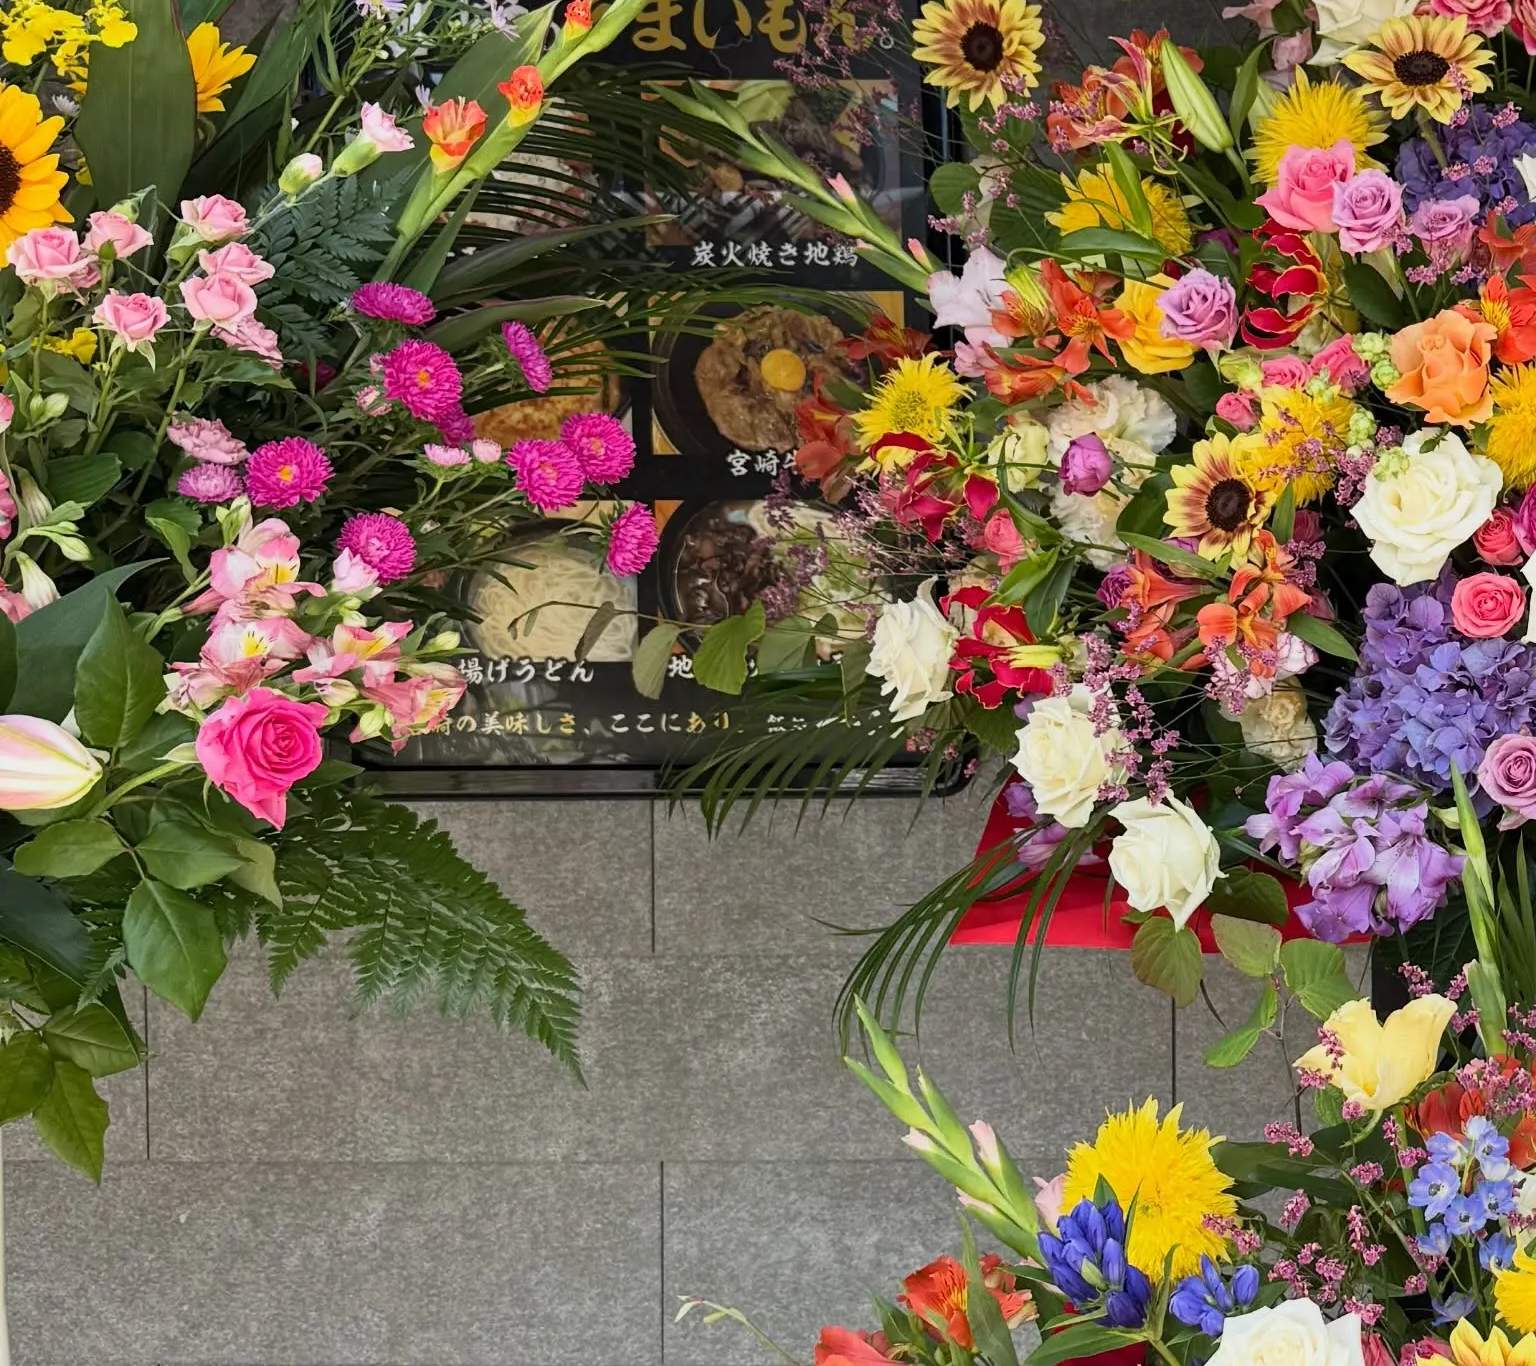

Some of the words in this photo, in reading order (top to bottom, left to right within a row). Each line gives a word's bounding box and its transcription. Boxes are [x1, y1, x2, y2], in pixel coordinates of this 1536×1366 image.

[690, 239, 859, 268] 炭火焼き地鶏
